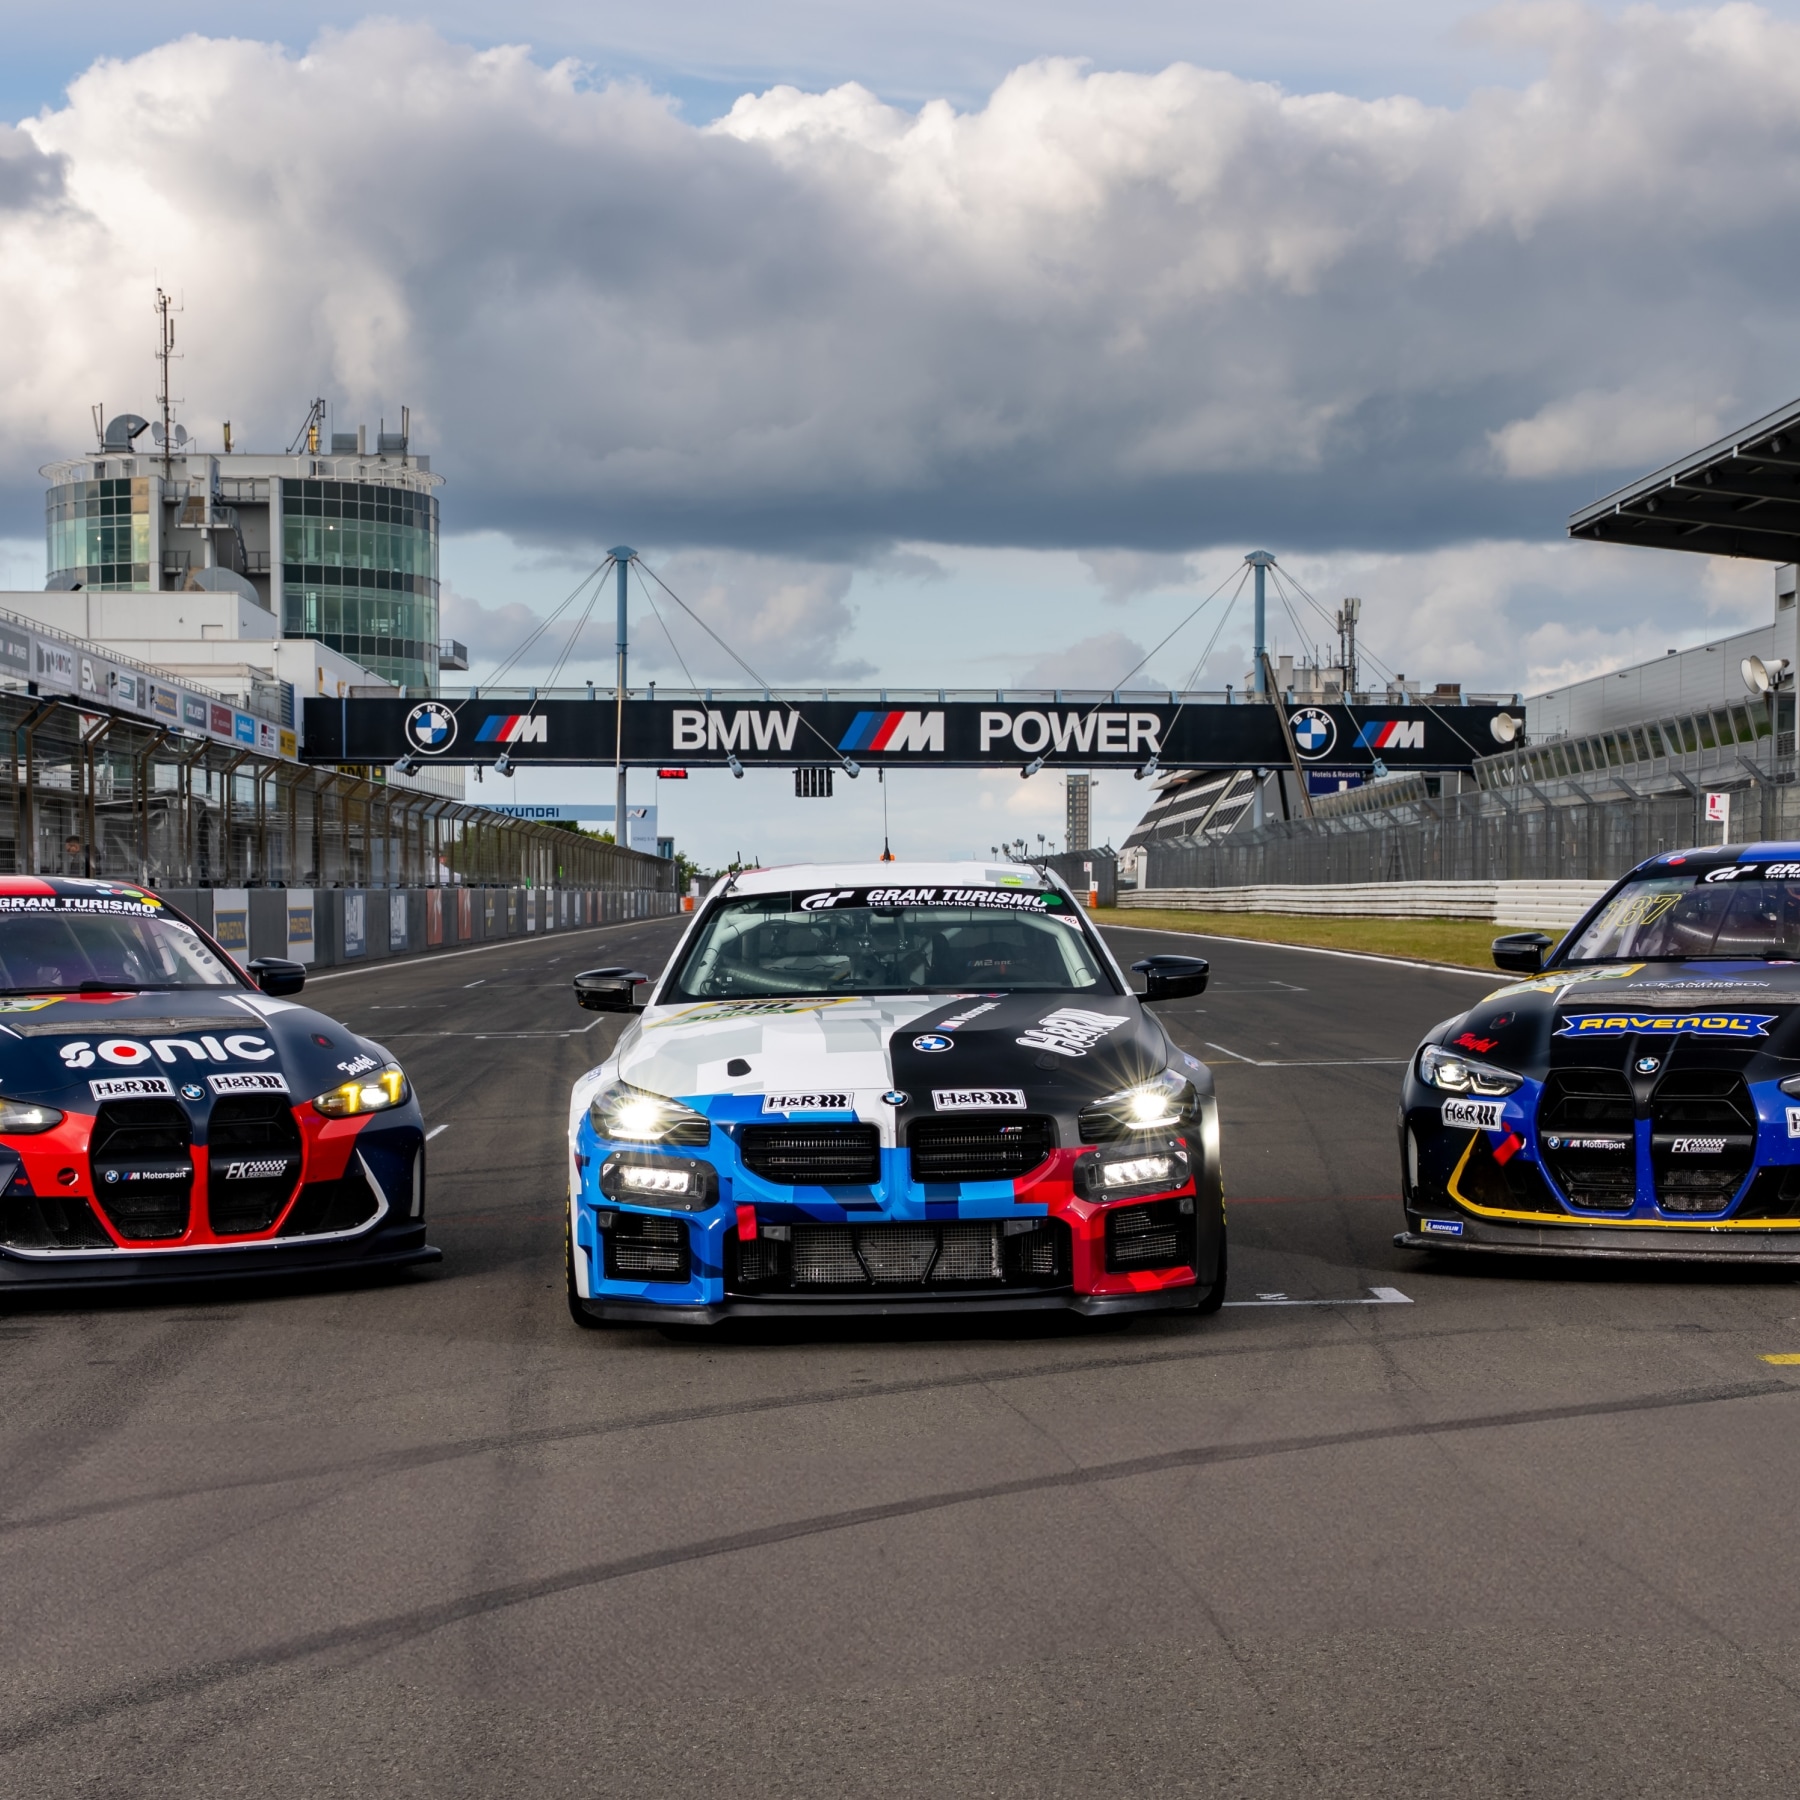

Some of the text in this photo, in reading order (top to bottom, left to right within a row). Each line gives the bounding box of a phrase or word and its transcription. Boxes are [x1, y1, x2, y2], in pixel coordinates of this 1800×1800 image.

[412, 704, 451, 720] BMW
[1293, 711, 1332, 725] BMW
[672, 709, 800, 750] BMW
[980, 711, 1162, 752] POWER
[495, 807, 560, 818] HYUNDAI
[866, 889, 937, 901] GRAN
[0, 897, 156, 914] GRAN TURISMO
[978, 902, 1047, 914] SIMULATOR
[1600, 893, 1682, 929] 187
[99, 908, 158, 919] SIMULATOR
[1578, 1017, 1749, 1031] RAVENOL
[337, 1053, 378, 1076] Teufel
[96, 1080, 142, 1096] H&R
[215, 1075, 257, 1090] H&R
[767, 1095, 816, 1108] H&R
[938, 1092, 986, 1105] H&R
[1444, 1102, 1478, 1122] H&R
[1582, 1140, 1626, 1151] Motorsport
[142, 1171, 187, 1180] Motorsport
[1431, 1224, 1460, 1232] MICHELIN
